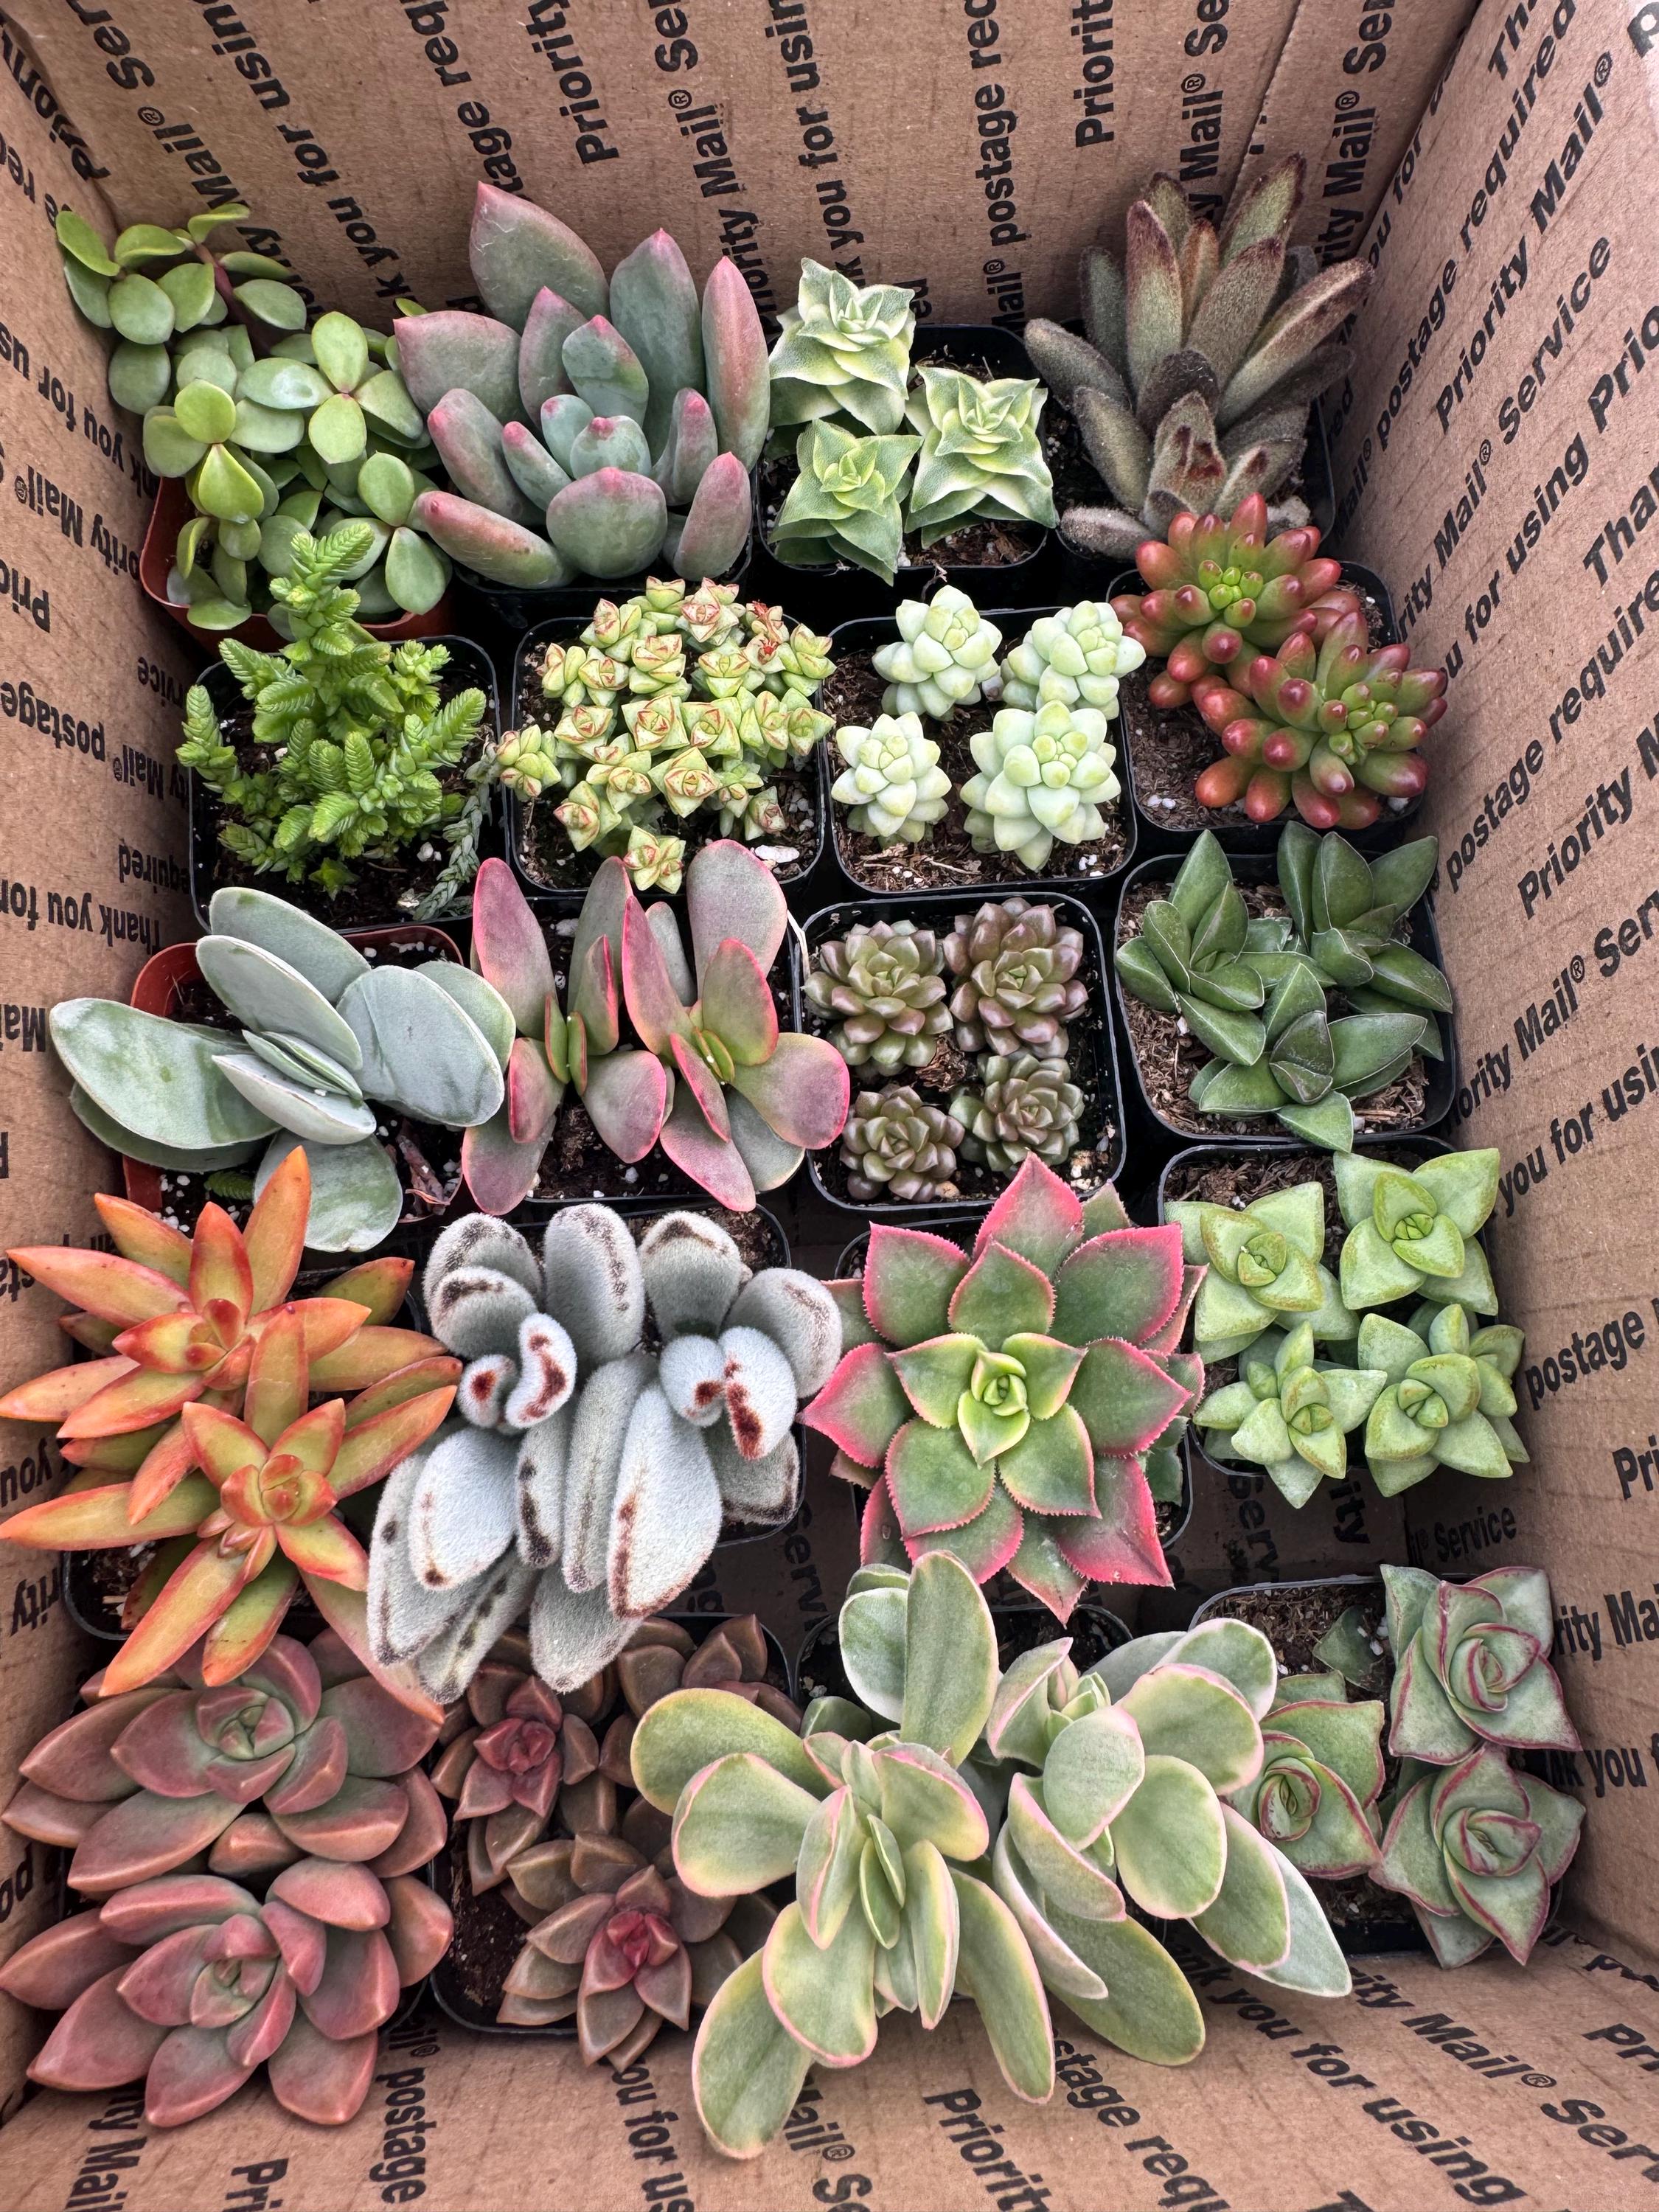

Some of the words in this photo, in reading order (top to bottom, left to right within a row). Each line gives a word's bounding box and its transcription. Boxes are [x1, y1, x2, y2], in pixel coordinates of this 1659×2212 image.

[193, 0, 290, 110] usin
[402, 0, 472, 87] req
[276, 124, 341, 187] for
[796, 106, 838, 169] for
[975, 83, 1026, 246] postage
[326, 196, 400, 267] you
[816, 180, 864, 251] you
[1377, 259, 1458, 451] postage
[1460, 0, 1576, 254] required
[1436, 236, 1528, 435] Priority
[1498, 237, 1610, 445] Service
[38, 366, 76, 432] for
[84, 407, 124, 472] you
[1465, 570, 1500, 645] for
[1506, 433, 1589, 574] using
[0, 681, 105, 762] postage
[1446, 740, 1543, 894] postage
[1517, 766, 1632, 919] Priority
[48, 893, 93, 931] you
[1498, 1145, 1548, 1217] you
[1549, 1102, 1594, 1165] for
[1525, 1311, 1644, 1411] postage
[0, 1437, 52, 1507] you
[1434, 1506, 1516, 1562] Service
[1585, 1747, 1647, 1798] you
[369, 2067, 437, 2203] postage
[624, 2110, 679, 2166] for
[1206, 1988, 1304, 2039] you
[1290, 2042, 1377, 2088] for
[1362, 2097, 1528, 2206] using
